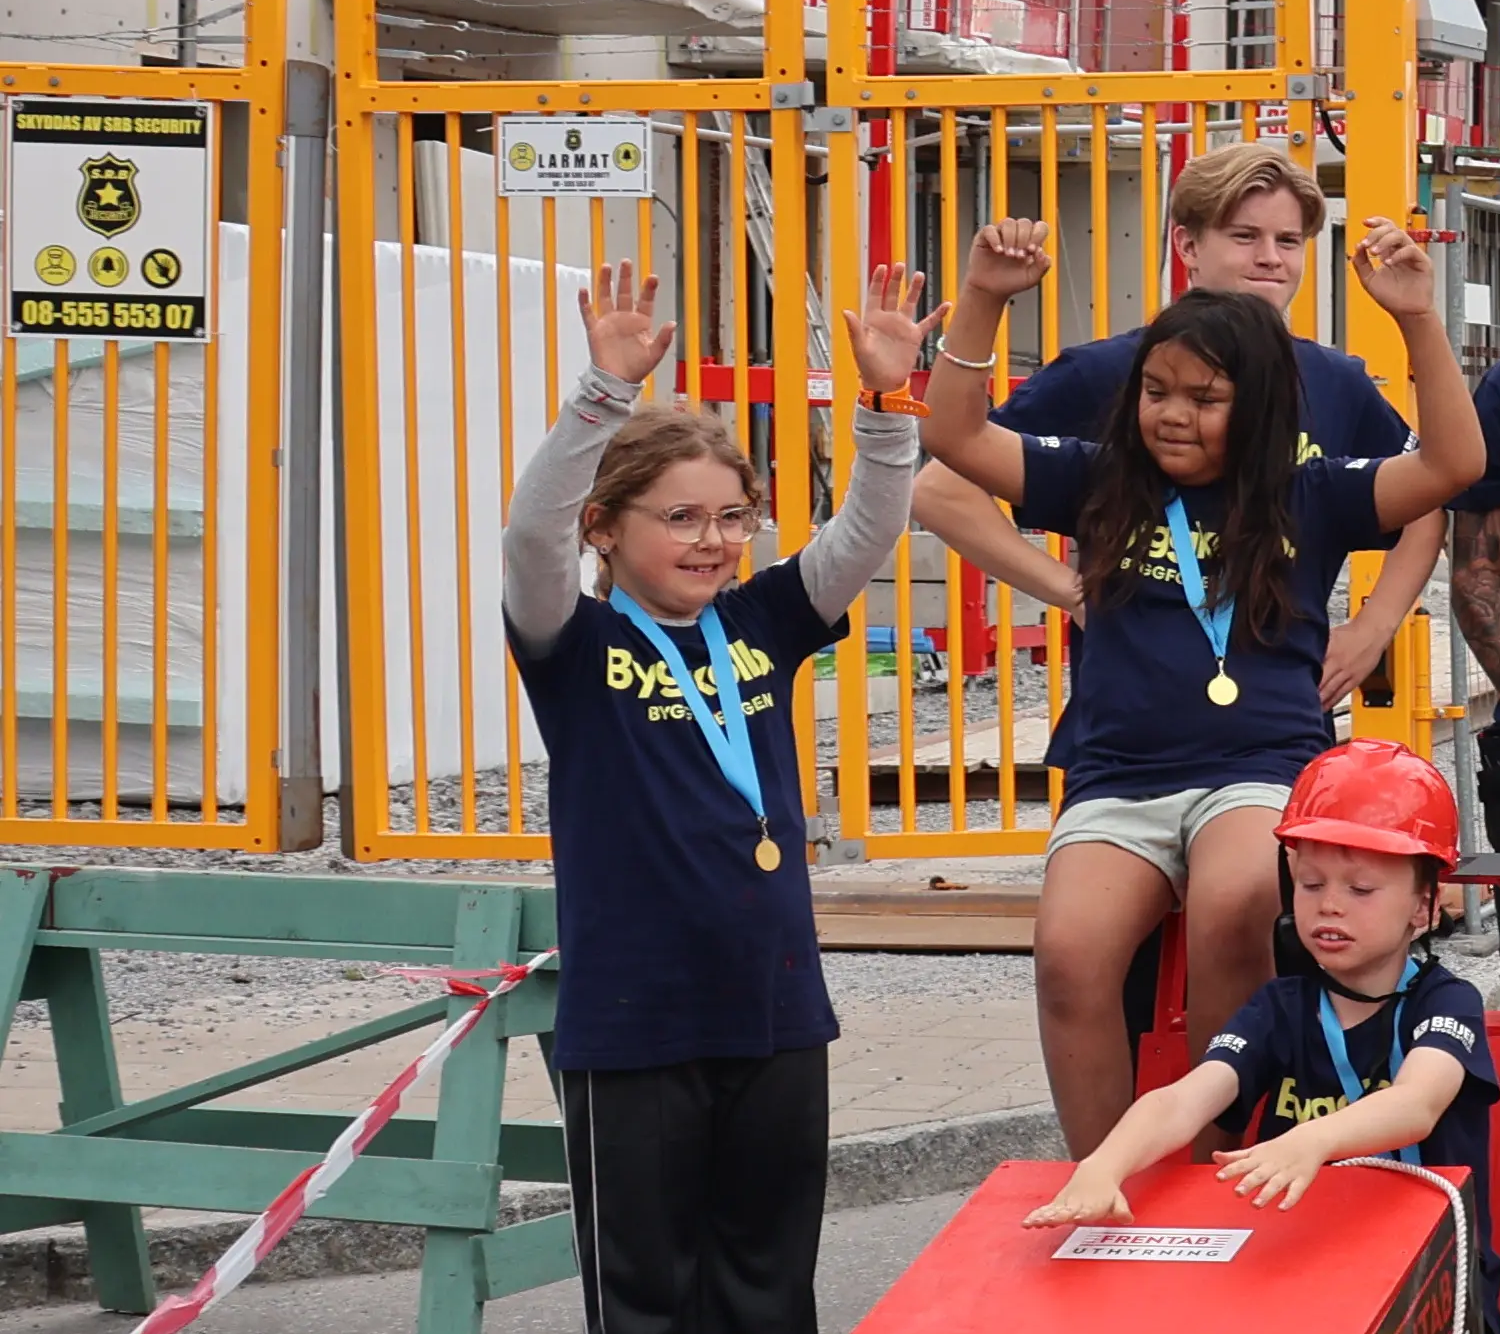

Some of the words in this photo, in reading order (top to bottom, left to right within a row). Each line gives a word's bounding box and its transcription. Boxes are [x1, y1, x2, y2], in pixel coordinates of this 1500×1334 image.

[17, 113, 81, 130] SKYDDAS
[83, 116, 102, 132] AV
[104, 117, 132, 133] SRB
[135, 117, 202, 135] SECURITY
[538, 153, 609, 169] LARMAT
[22, 300, 111, 327] 08-555
[113, 301, 161, 329] 553
[165, 304, 195, 330] 07
[1100, 1234, 1211, 1246] FRENTAB
[1072, 1247, 1220, 1258] UTHYRNING
